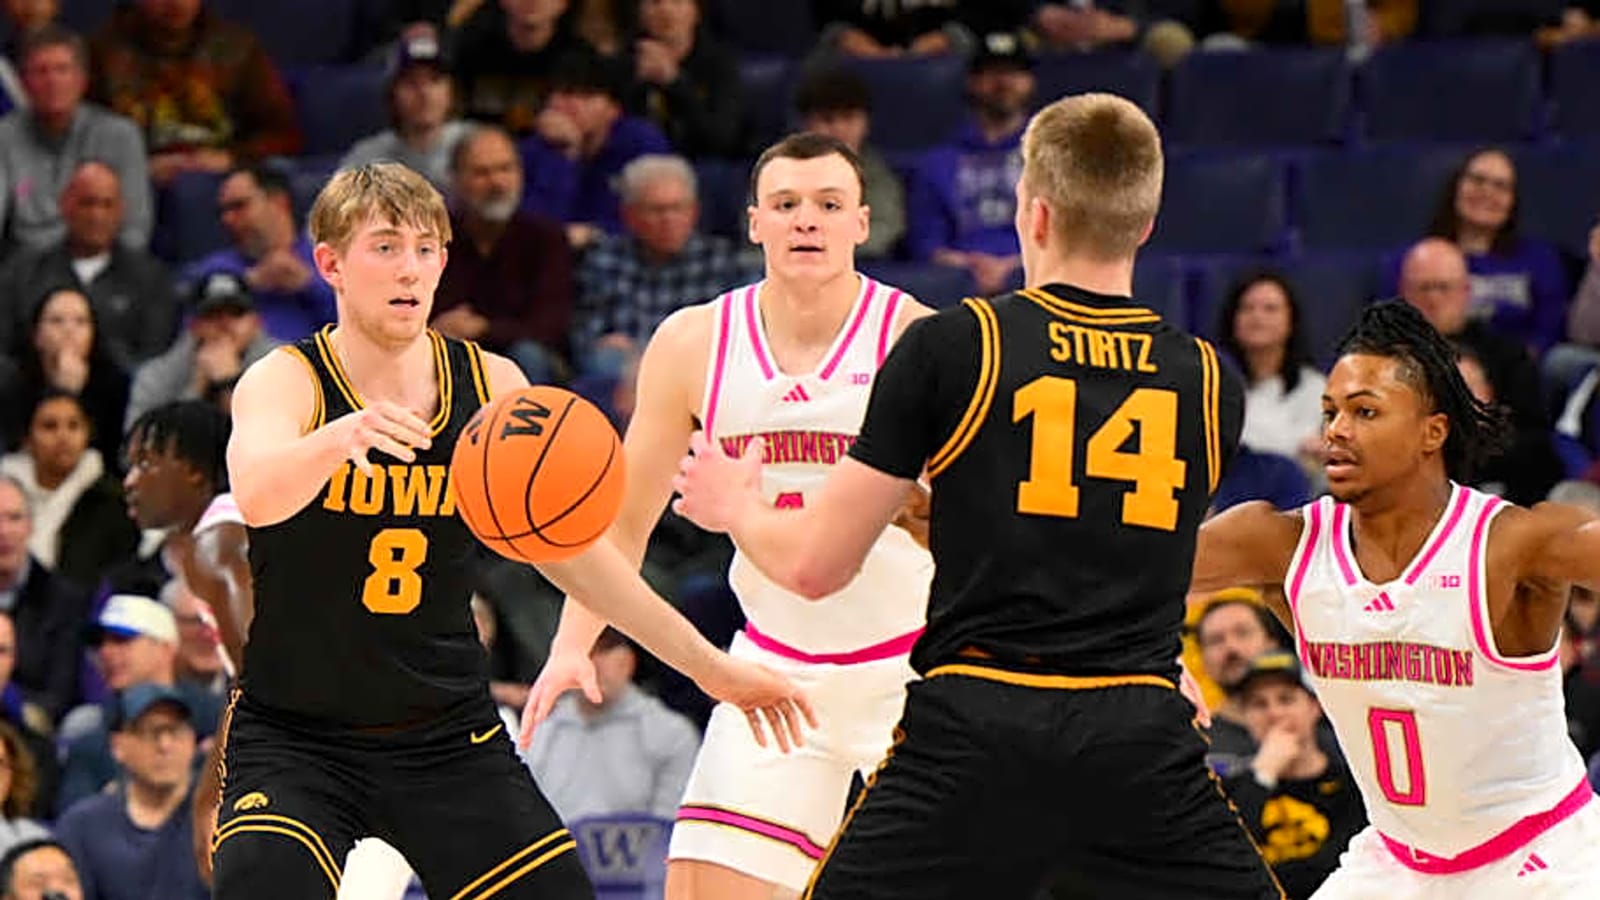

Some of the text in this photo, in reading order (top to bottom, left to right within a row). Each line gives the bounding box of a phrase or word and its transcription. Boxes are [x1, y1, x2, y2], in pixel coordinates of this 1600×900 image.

[1048, 321, 1158, 373] STIRTZ
[500, 397, 551, 440] W
[1012, 375, 1187, 532] 14
[362, 528, 429, 614] 8
[1307, 641, 1473, 686] WASHINGTON
[1367, 707, 1425, 806] 0
